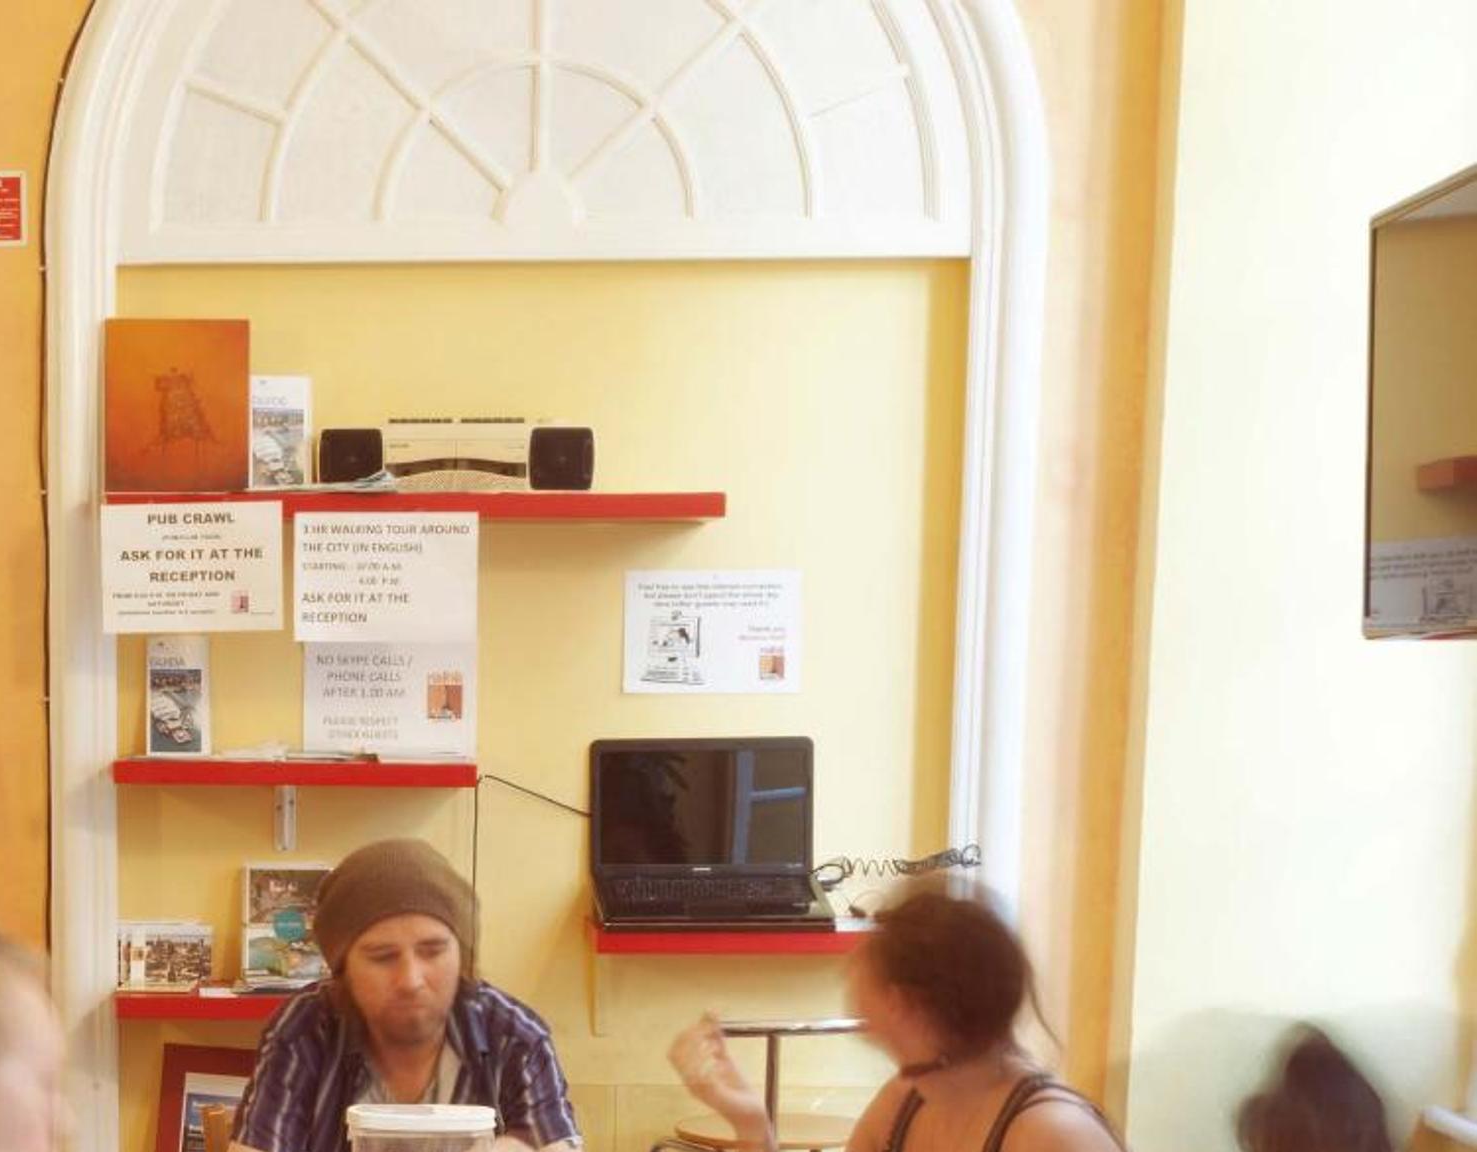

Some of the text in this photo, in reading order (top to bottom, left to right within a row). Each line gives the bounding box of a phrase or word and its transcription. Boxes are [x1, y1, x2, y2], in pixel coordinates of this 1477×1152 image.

[147, 512, 236, 525] PUB CRAWL
[331, 525, 383, 535] WALKING
[386, 524, 417, 535] TOUR
[418, 524, 470, 535] AROUND
[302, 542, 324, 553] THE
[120, 547, 263, 562] ASK FOR IT AT THE
[148, 570, 236, 583] RECEPTION
[301, 592, 410, 604] ASK FOR IT AT THE
[301, 611, 368, 623] RECEPTION
[316, 655, 334, 666] NO
